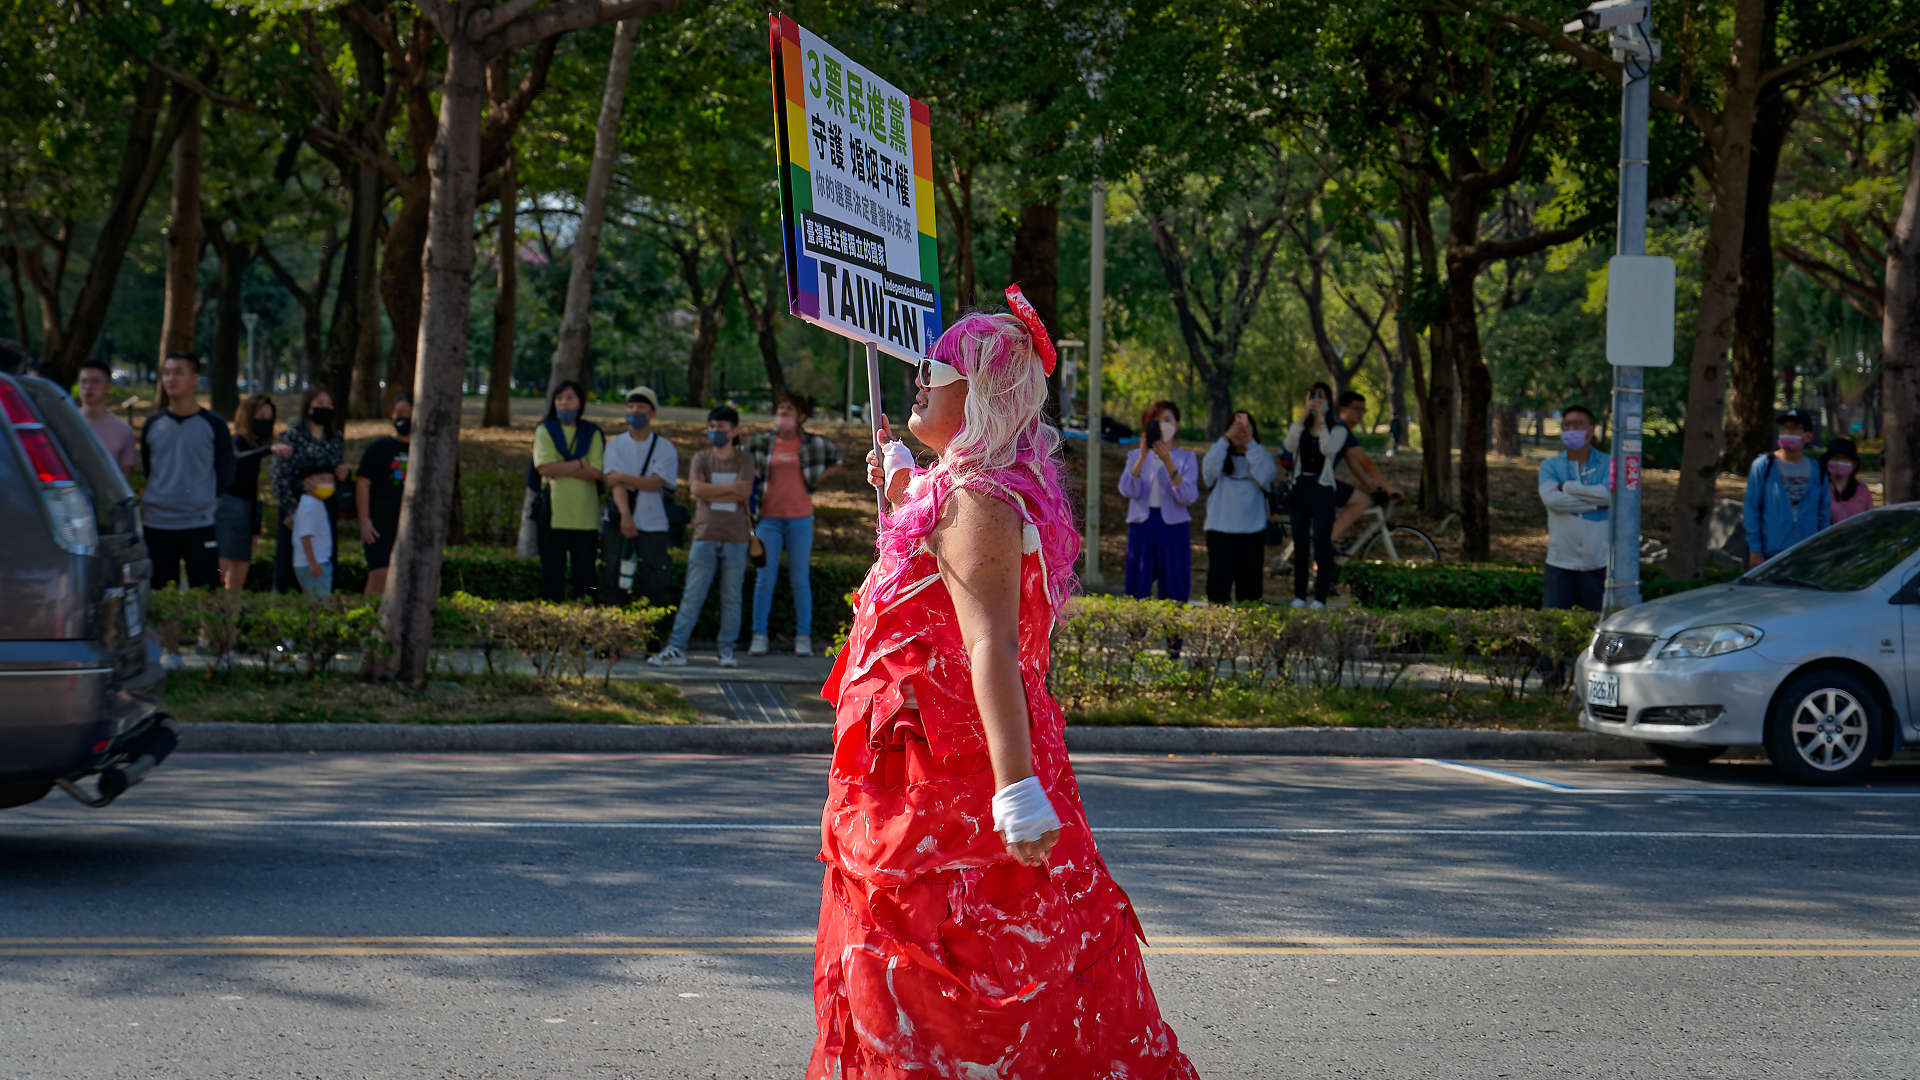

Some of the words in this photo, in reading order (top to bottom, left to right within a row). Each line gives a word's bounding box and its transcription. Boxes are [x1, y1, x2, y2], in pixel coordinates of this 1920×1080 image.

[807, 49, 907, 156] 3票民進黨
[811, 112, 845, 172] 守護
[820, 260, 919, 353] TAIWAN
[885, 277, 915, 298] Independent
